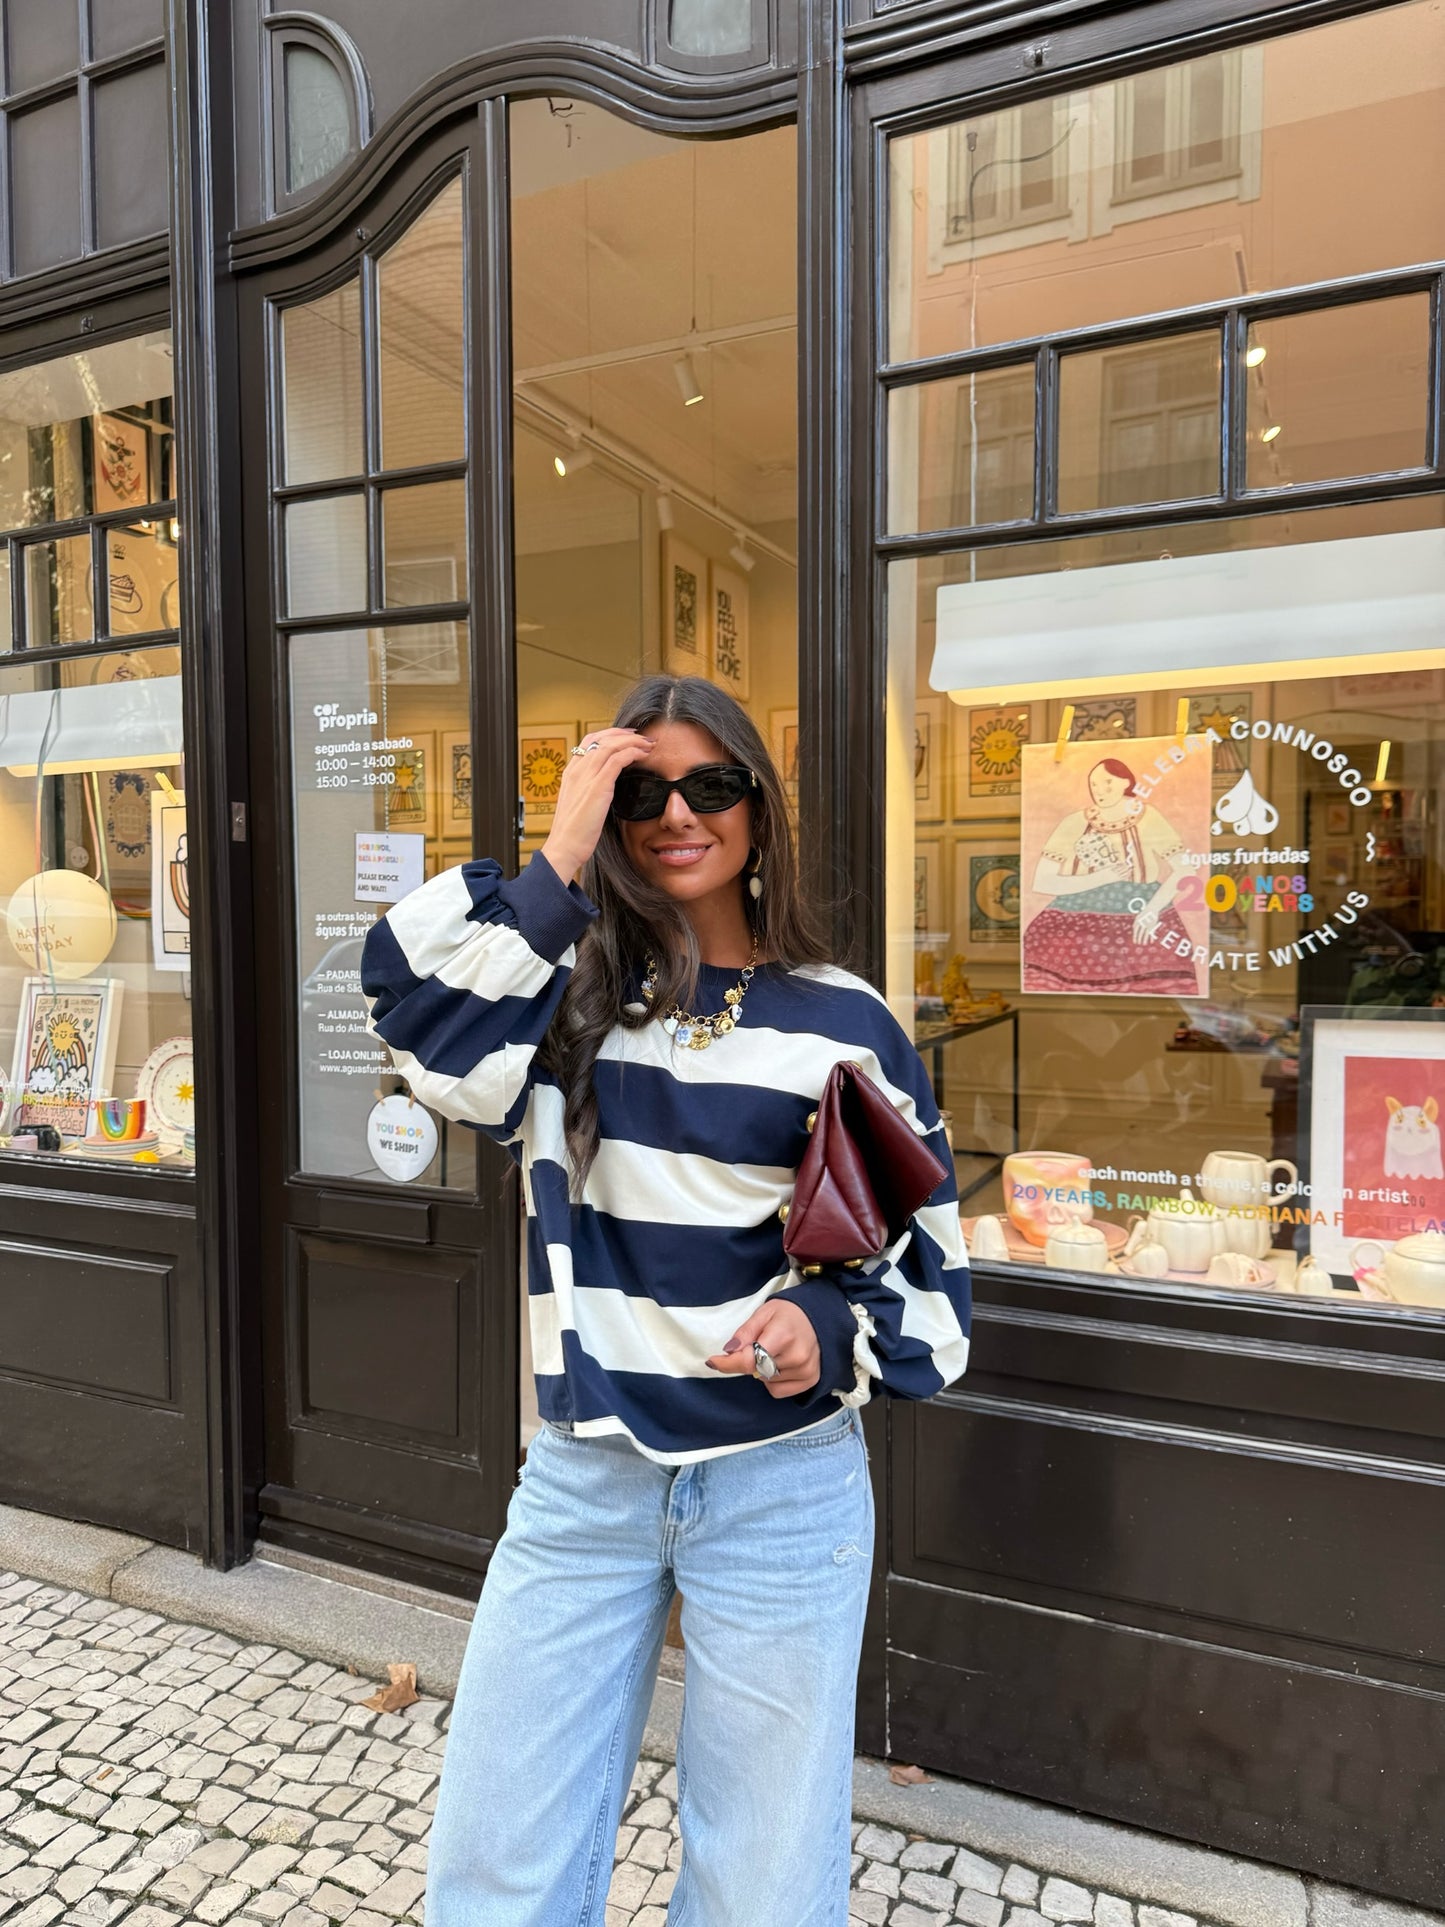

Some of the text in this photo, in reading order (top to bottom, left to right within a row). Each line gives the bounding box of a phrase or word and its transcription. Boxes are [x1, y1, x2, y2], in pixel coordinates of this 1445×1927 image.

[718, 610, 737, 636] FEEL
[717, 632, 736, 656] LIKE
[717, 650, 740, 680] HOME
[314, 704, 339, 716] cor
[320, 708, 378, 732] propria
[314, 736, 413, 756] segunda a sabado
[315, 758, 348, 772] 10:00
[362, 755, 396, 768] 14:00
[1125, 720, 1372, 816] CELEBRA CONNOSCO
[316, 775, 348, 788] 15:00
[362, 772, 396, 785] 19:00
[1181, 847, 1310, 868] águas furtadas
[378, 874, 399, 882] KNOCK
[1176, 874, 1306, 913] 20 ANOS
[1239, 894, 1315, 913] YEARS
[327, 912, 356, 921] outras
[356, 912, 377, 923] lojas
[16, 924, 55, 938] HAPPY
[316, 922, 347, 940] águas
[1127, 891, 1370, 972] CELEBRATE WITH US
[326, 970, 361, 980] PADARI
[317, 984, 334, 992] Rua
[334, 984, 345, 992] de
[327, 1010, 365, 1020] ALMADA
[318, 1024, 334, 1032] Rua
[336, 1024, 346, 1032] do
[328, 1050, 352, 1060] LOJA
[352, 1050, 386, 1060] ONLINE
[320, 1064, 398, 1075] www.aguasfurtada
[376, 1122, 394, 1134] YOU
[380, 1139, 418, 1154] WE SHIP!
[1078, 1166, 1119, 1180] each
[1120, 1168, 1177, 1185] month
[1180, 1174, 1192, 1186] a
[1261, 1182, 1272, 1193] a
[1358, 1187, 1410, 1204] artist
[1013, 1184, 1038, 1200] 20
[1043, 1188, 1113, 1210] YEARS,
[1227, 1204, 1327, 1226] ADRIANA
